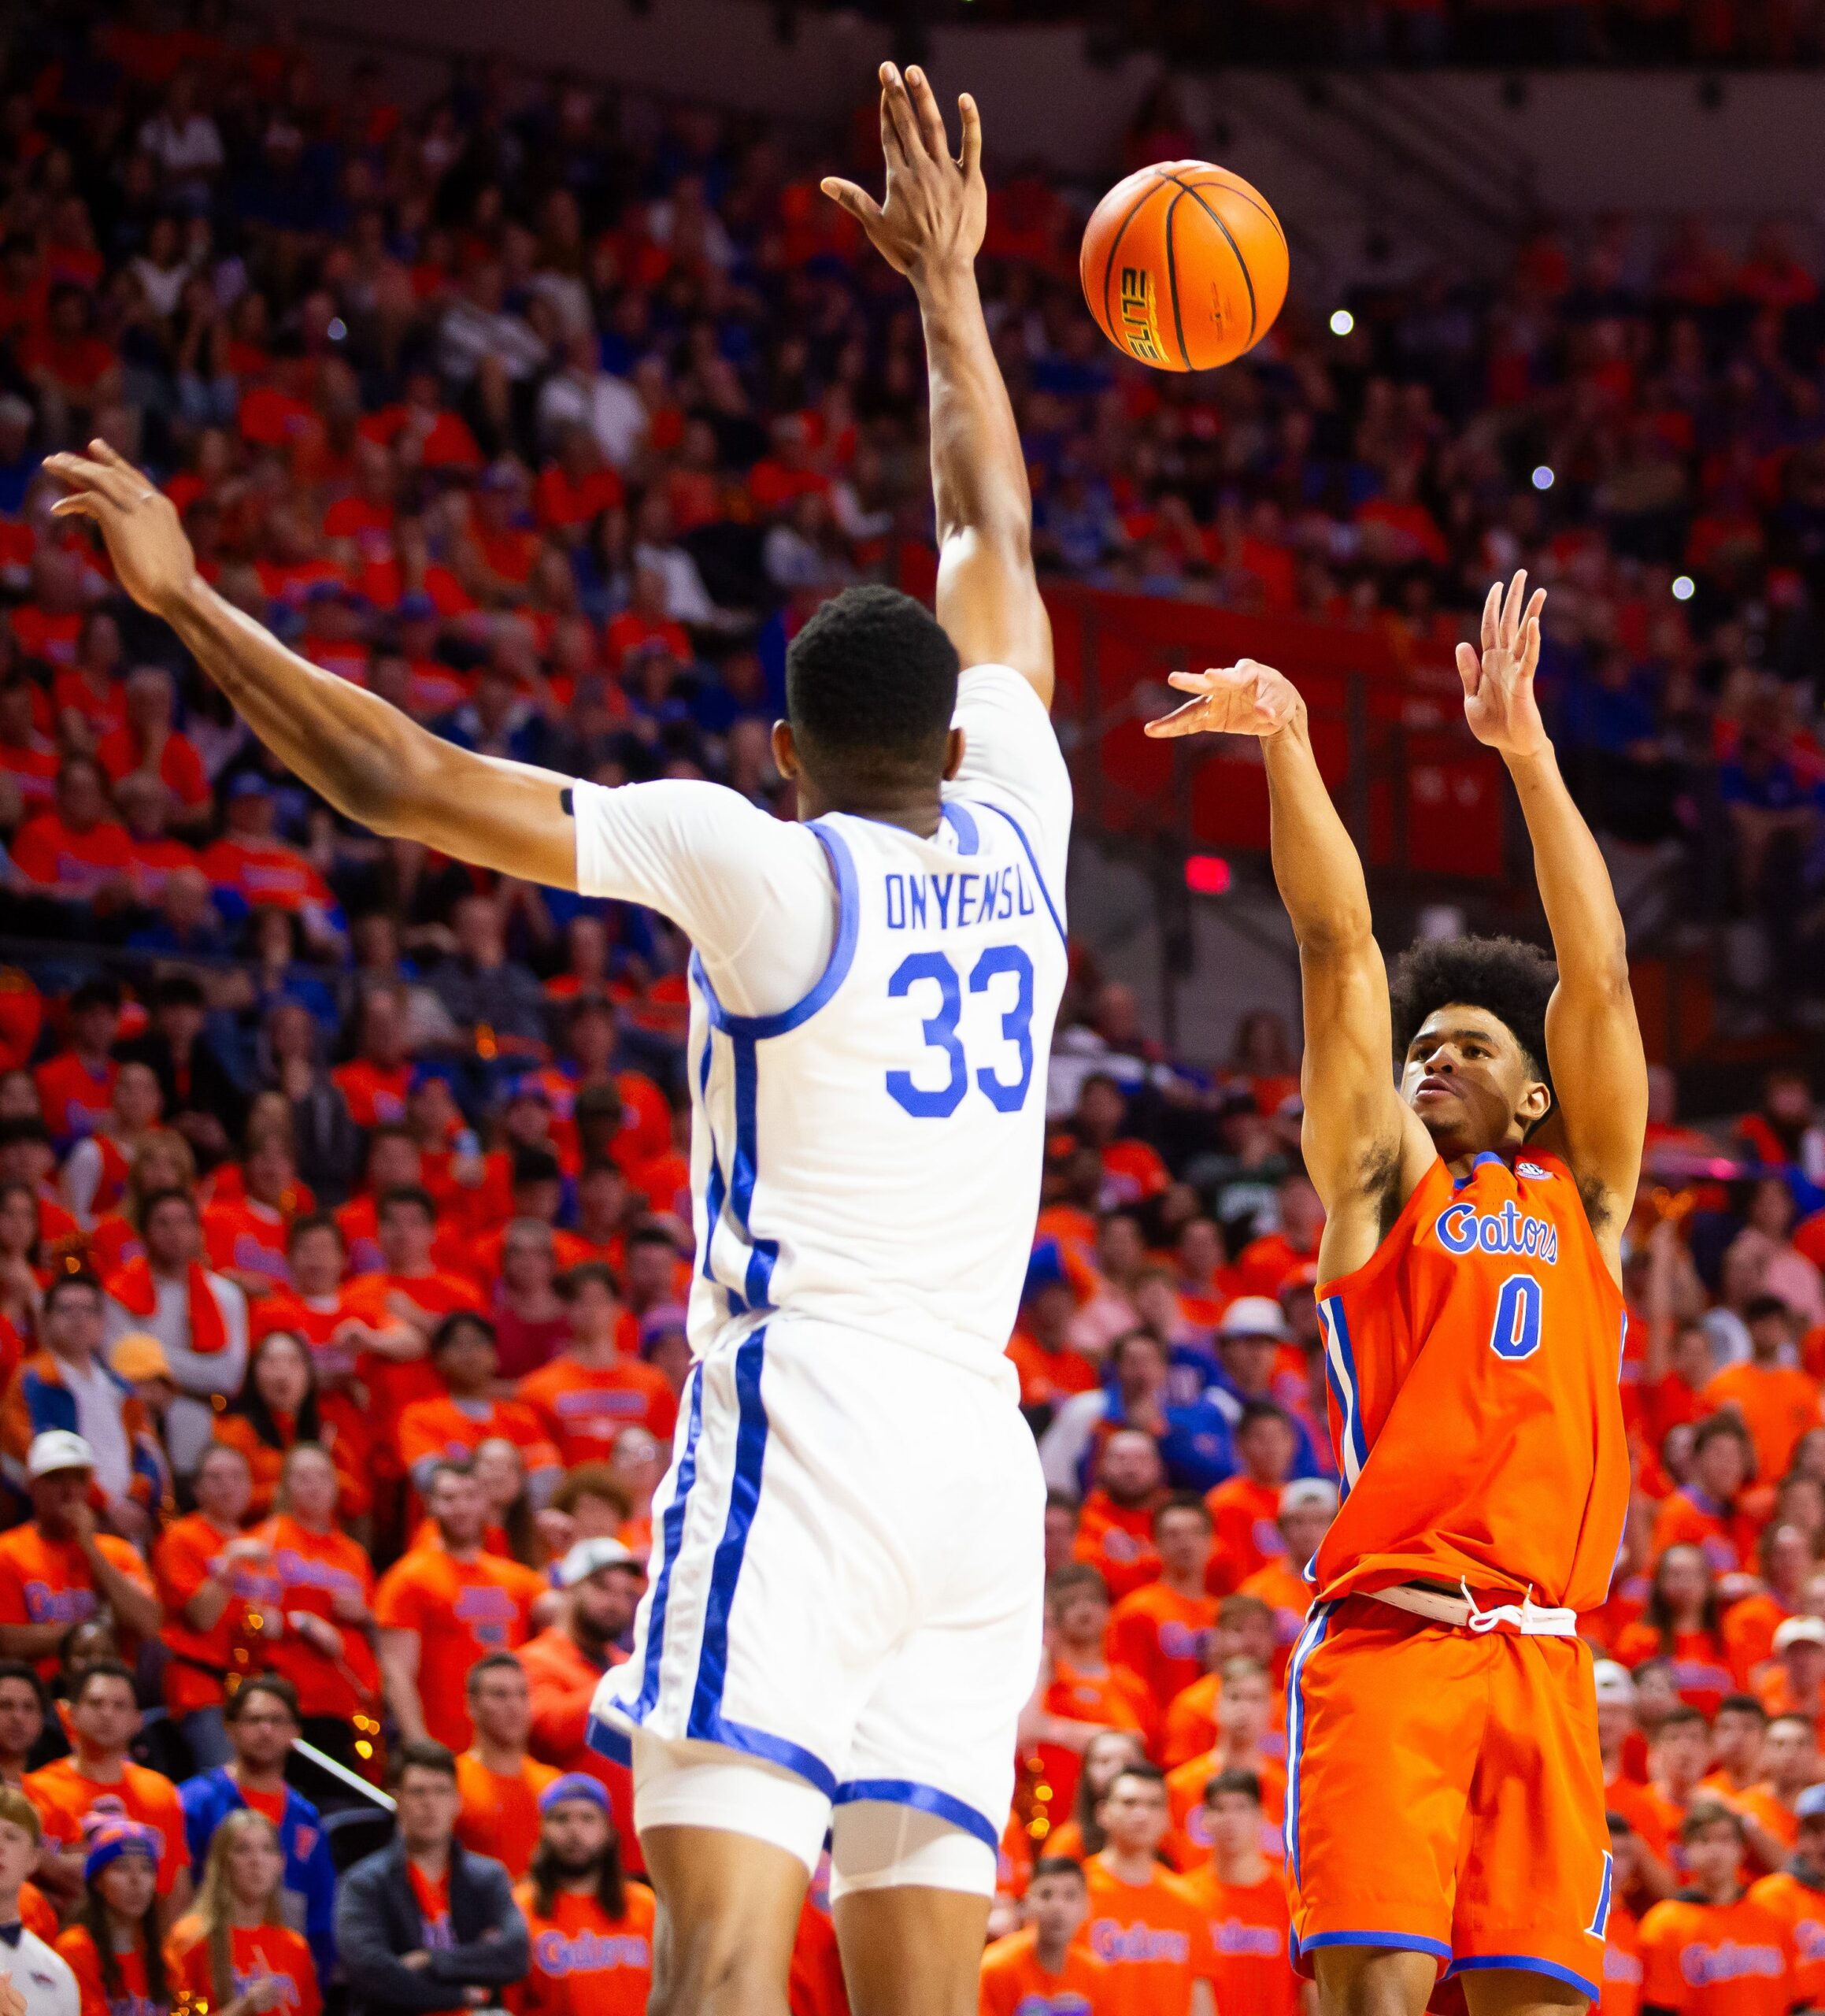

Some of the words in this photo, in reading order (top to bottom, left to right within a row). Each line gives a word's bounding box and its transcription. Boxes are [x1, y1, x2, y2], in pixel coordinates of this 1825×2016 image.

[1121, 266, 1159, 360] ELITE
[886, 944, 1034, 1117] 33
[1435, 1199, 1558, 1265] Gators
[1490, 1273, 1542, 1360] 0
